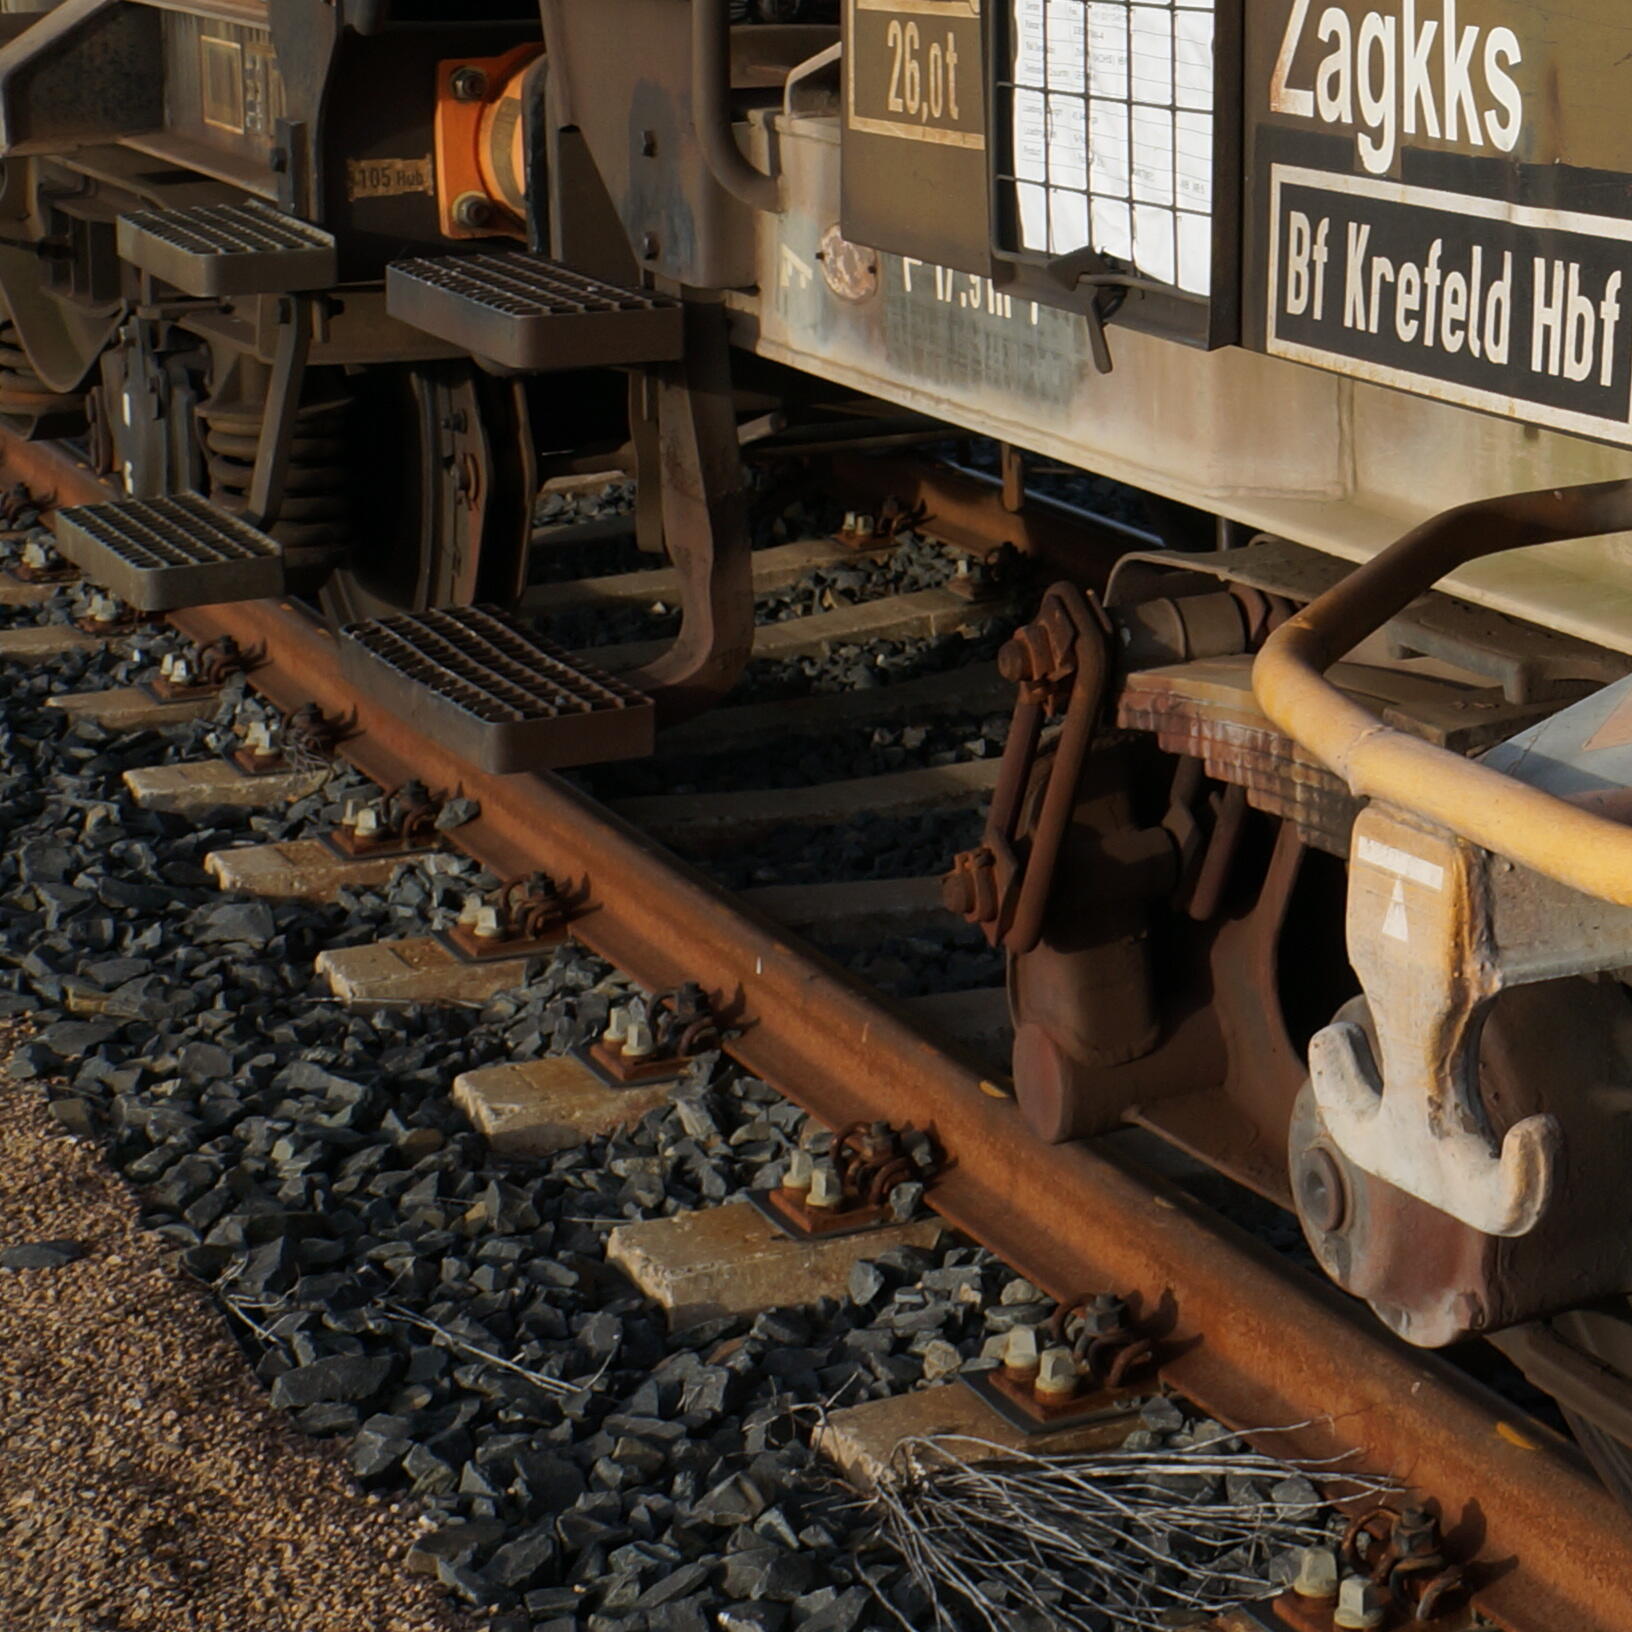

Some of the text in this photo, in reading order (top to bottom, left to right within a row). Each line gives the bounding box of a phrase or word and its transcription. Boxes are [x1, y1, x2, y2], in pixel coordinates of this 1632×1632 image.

[1286, 210, 1622, 388] Bf Krefeld Hbf
